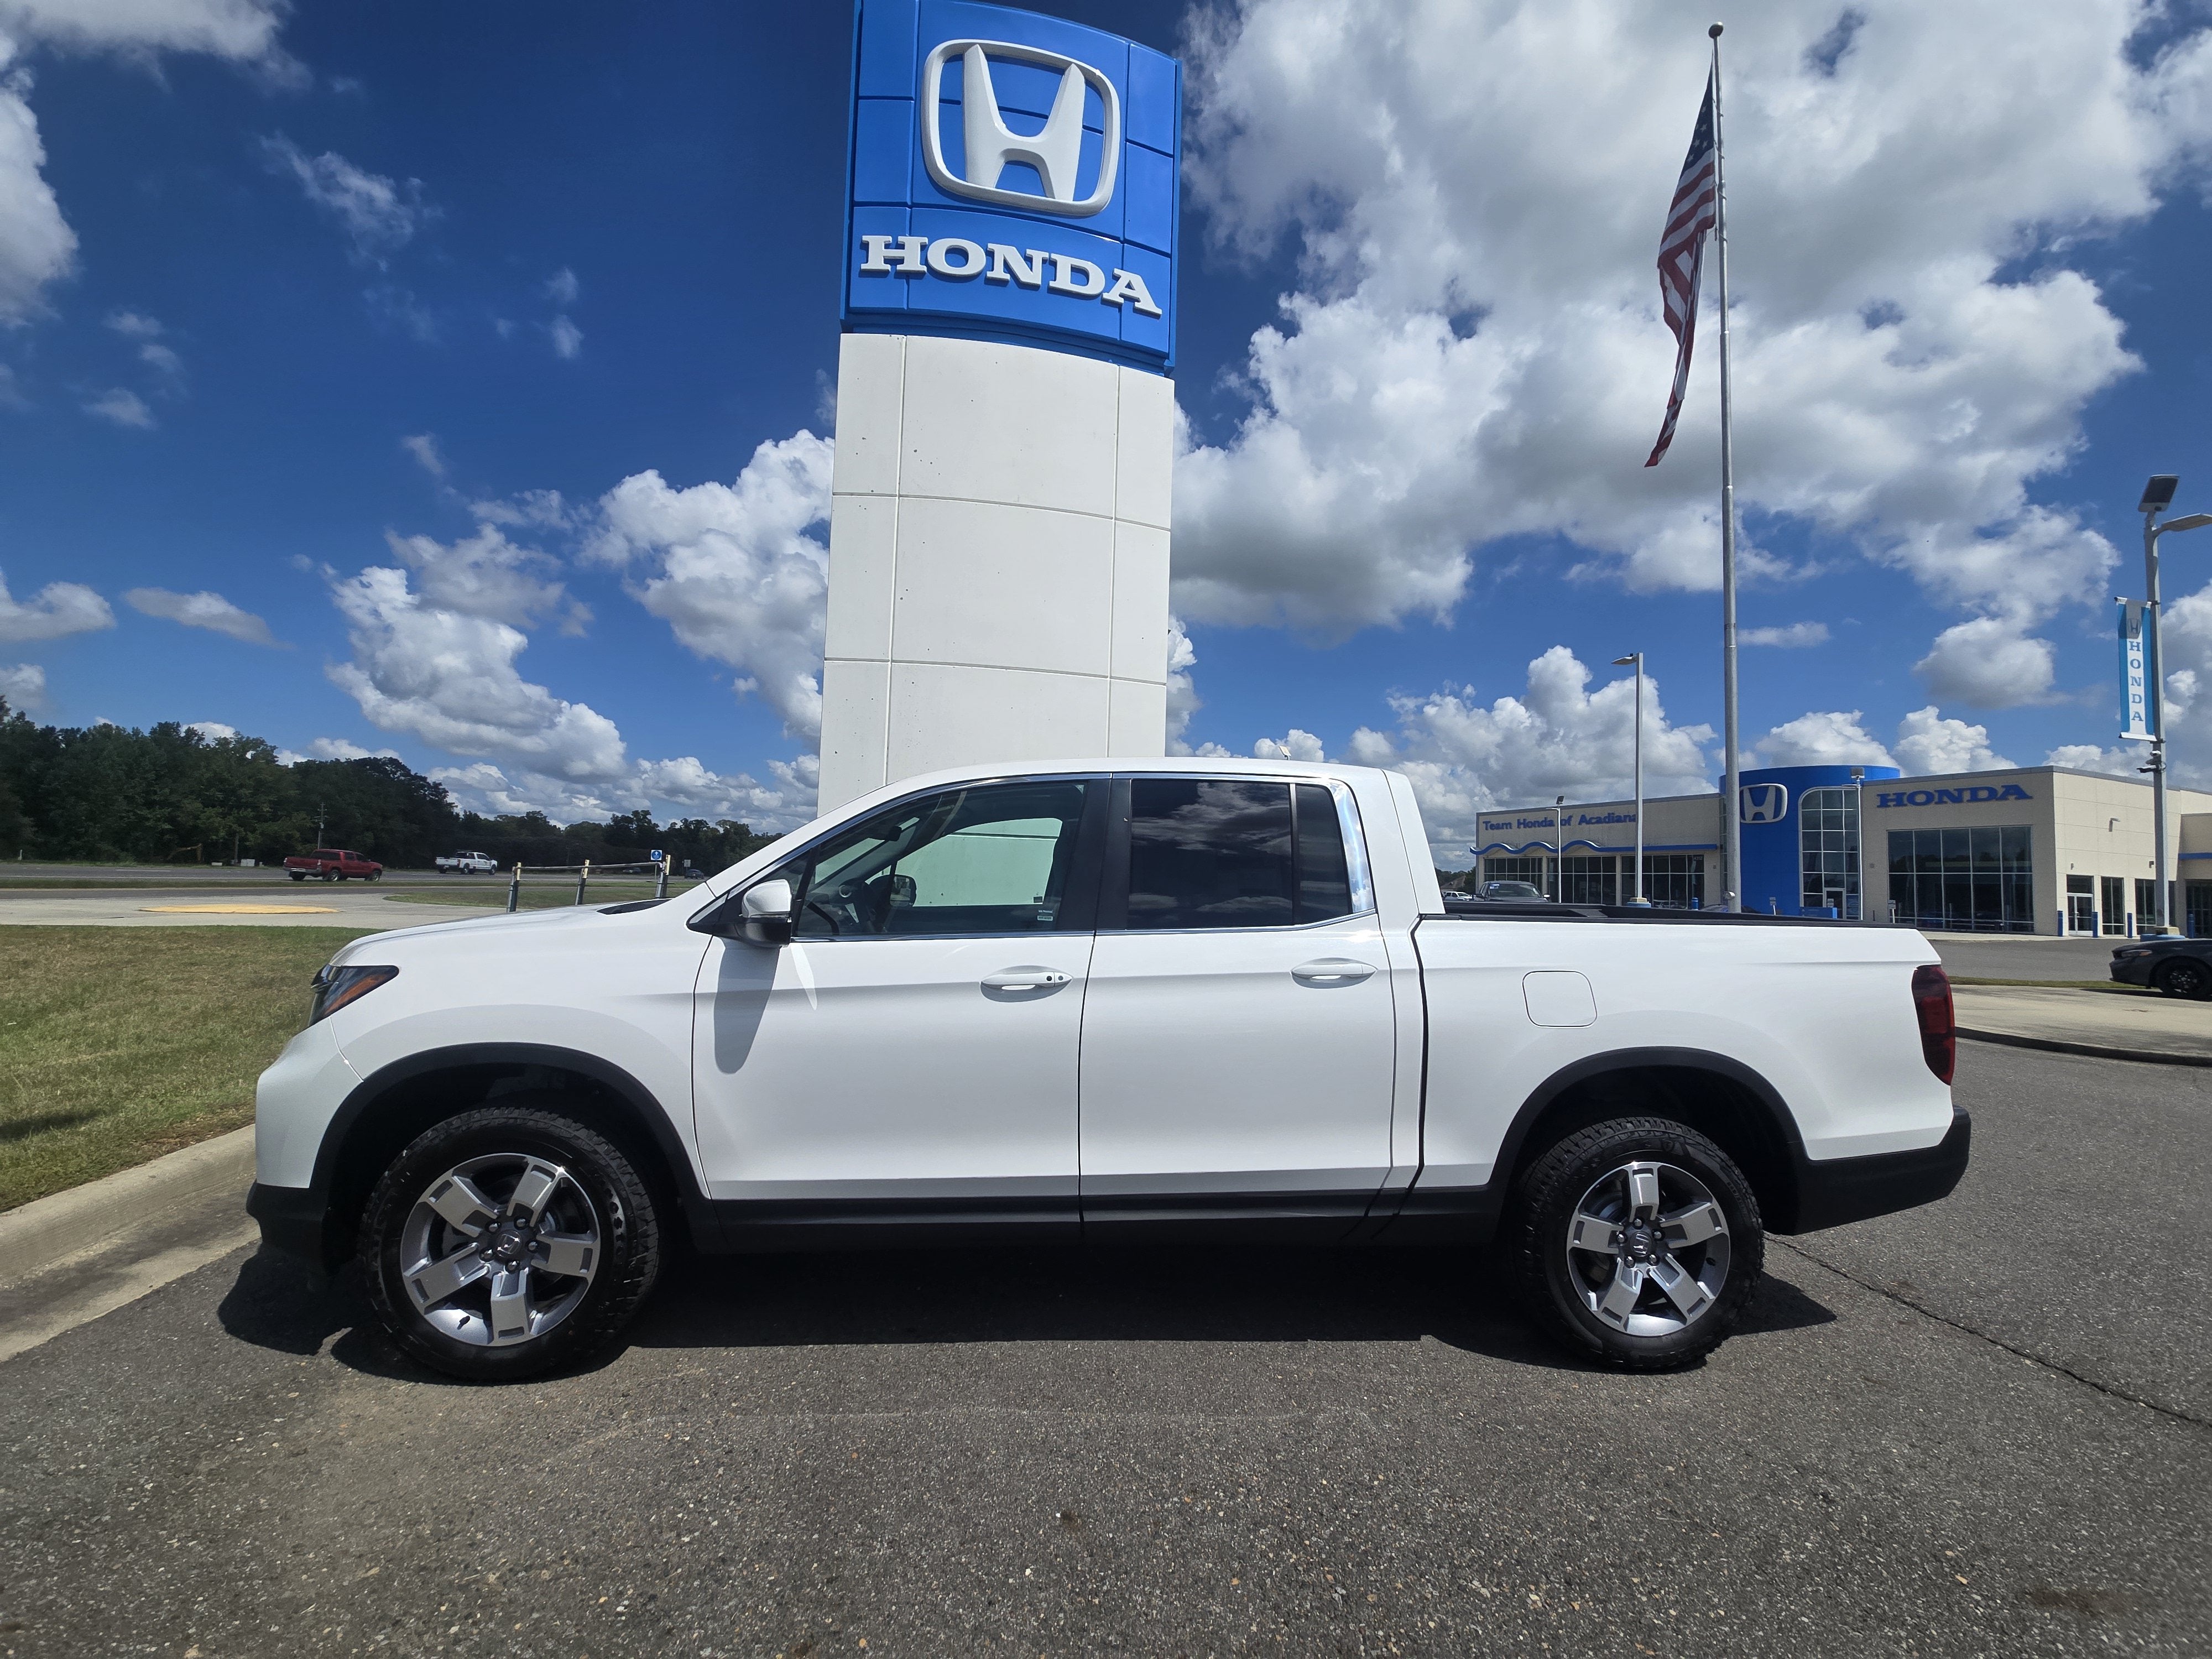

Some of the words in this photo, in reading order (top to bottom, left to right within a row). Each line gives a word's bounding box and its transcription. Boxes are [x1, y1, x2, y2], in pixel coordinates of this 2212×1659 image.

[860, 235, 1162, 319] HONDA
[2129, 641, 2143, 722] HONDA
[1876, 784, 2033, 808] HONDA
[1483, 821, 1512, 831] Team
[1517, 817, 1555, 828] Honda
[1560, 815, 1573, 826] of
